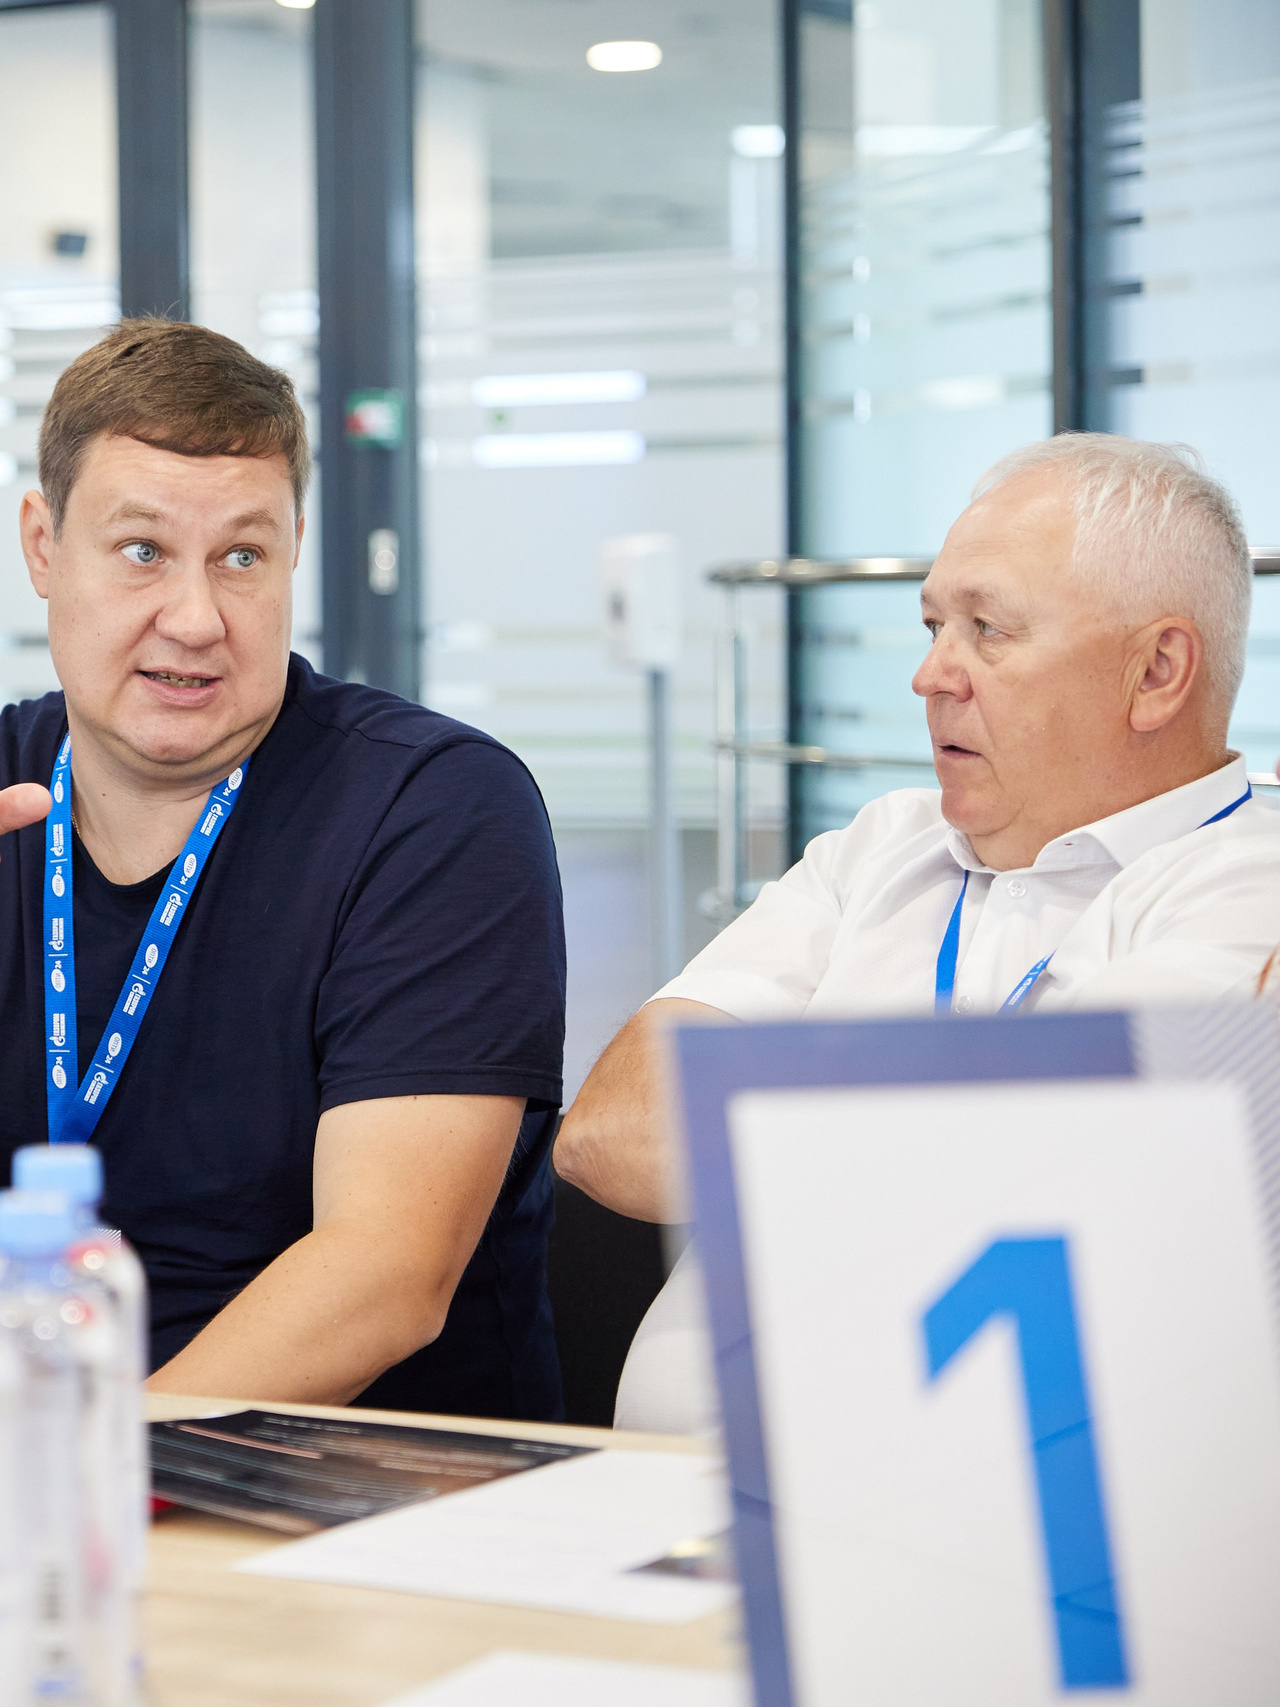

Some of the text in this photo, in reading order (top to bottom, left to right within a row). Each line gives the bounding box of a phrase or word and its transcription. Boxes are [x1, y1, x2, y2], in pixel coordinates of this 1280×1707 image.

[223, 787, 231, 797] 24
[55, 866, 62, 874] 24
[179, 875, 188, 885] 24
[54, 960, 62, 969] 24
[141, 965, 150, 975] 24
[55, 1056, 62, 1065] 24
[104, 1055, 113, 1064] 24
[919, 1231, 1132, 1693] 1
